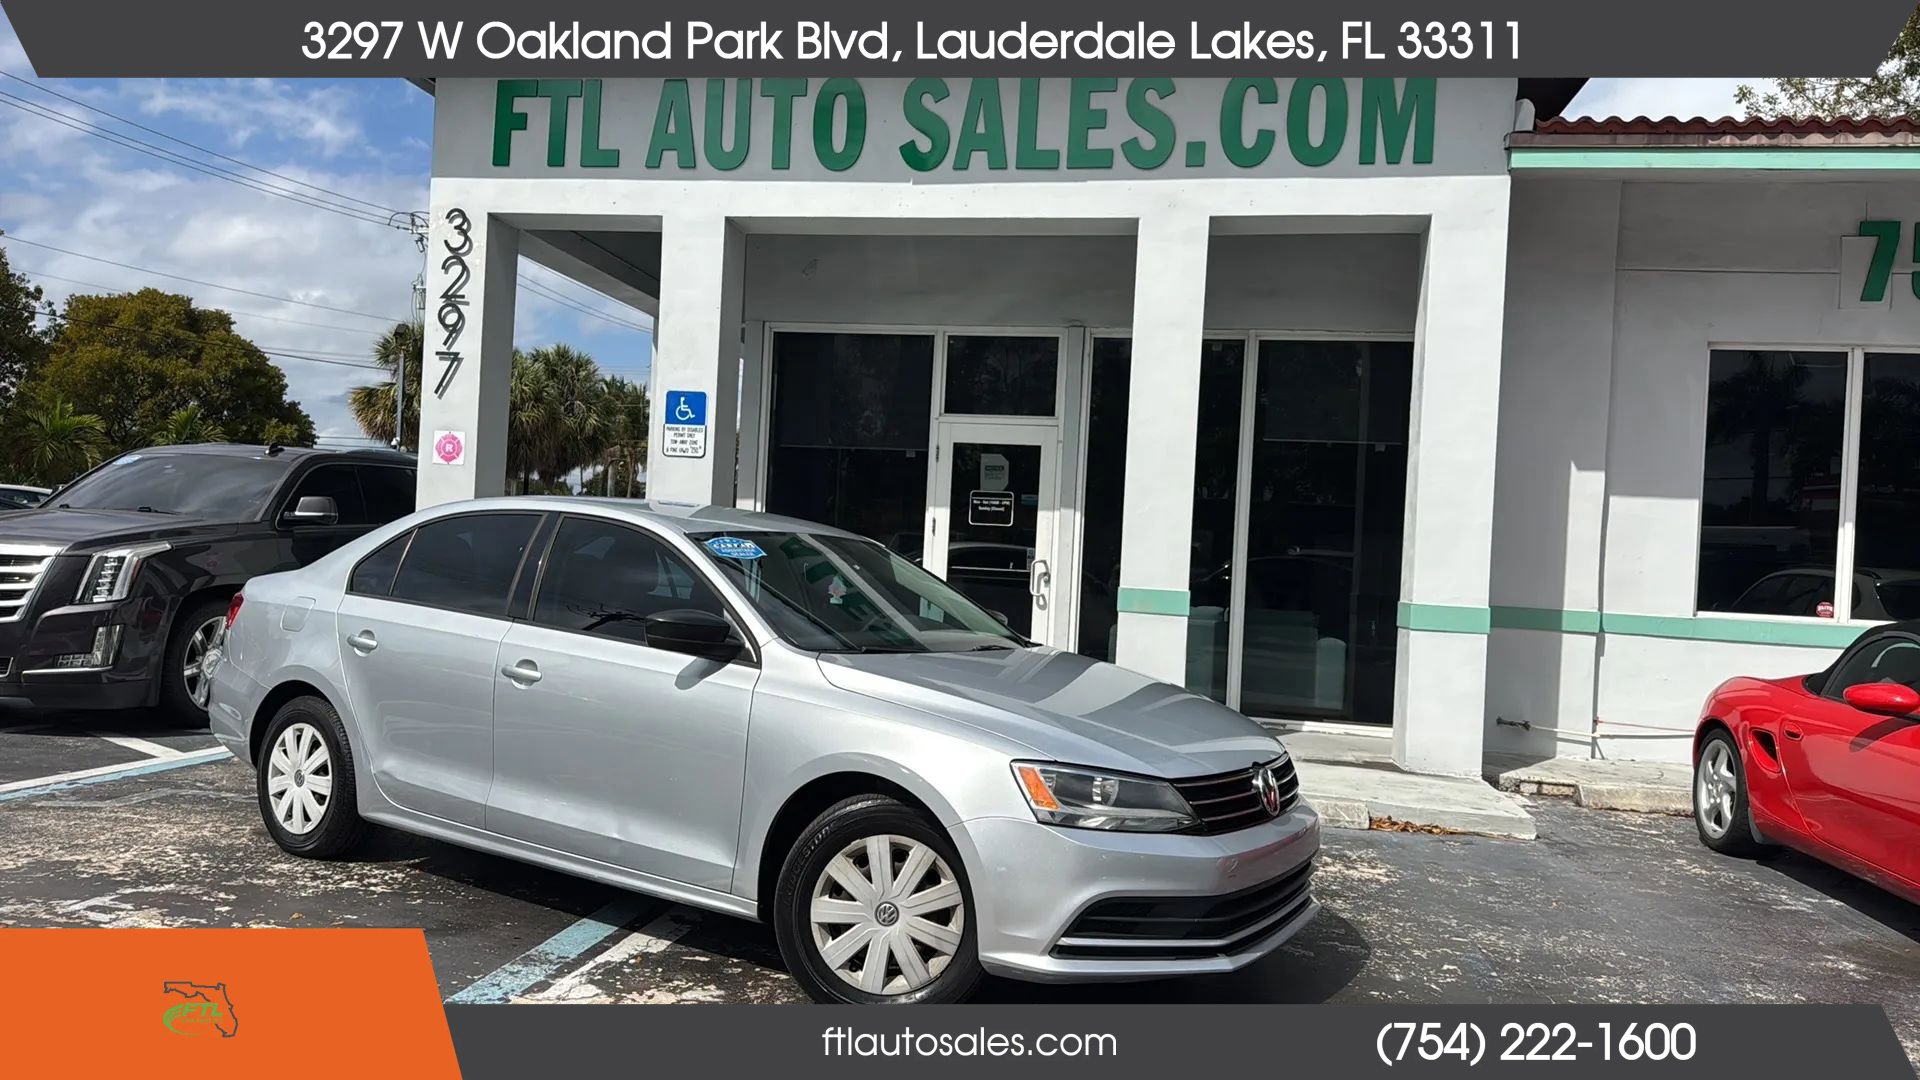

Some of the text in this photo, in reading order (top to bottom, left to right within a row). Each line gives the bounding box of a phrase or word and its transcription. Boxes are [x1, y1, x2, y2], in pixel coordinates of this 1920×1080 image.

[492, 77, 1437, 171] FTL AUTO SALES.COM
[434, 207, 471, 397] 3297
[1859, 220, 1920, 302] 7
[445, 443, 454, 453] R
